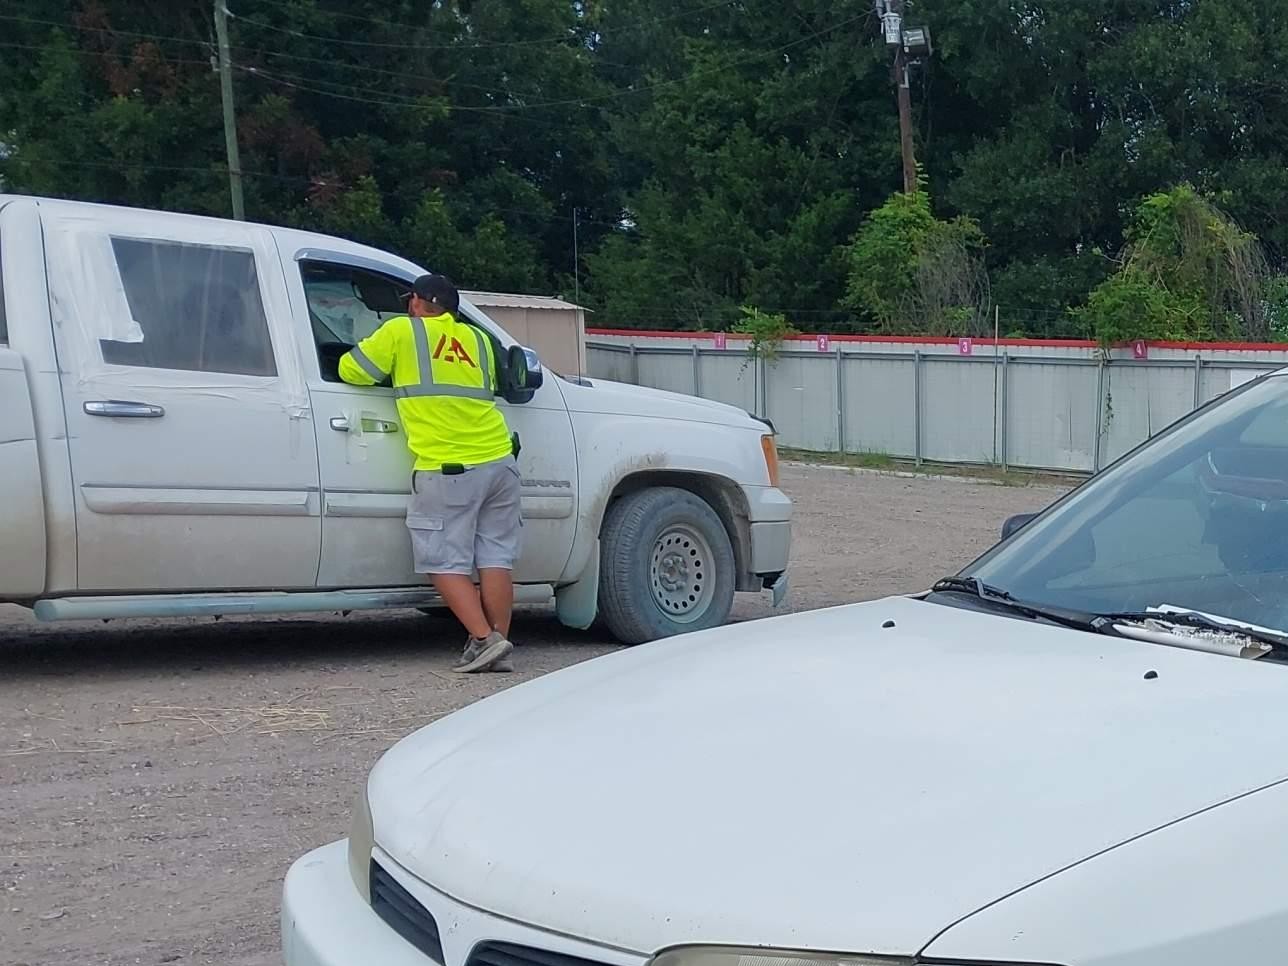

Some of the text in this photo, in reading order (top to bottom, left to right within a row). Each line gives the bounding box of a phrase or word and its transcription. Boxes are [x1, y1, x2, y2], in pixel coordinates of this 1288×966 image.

[820, 337, 825, 348] 2
[962, 341, 968, 352] 3
[1136, 343, 1142, 355] 4
